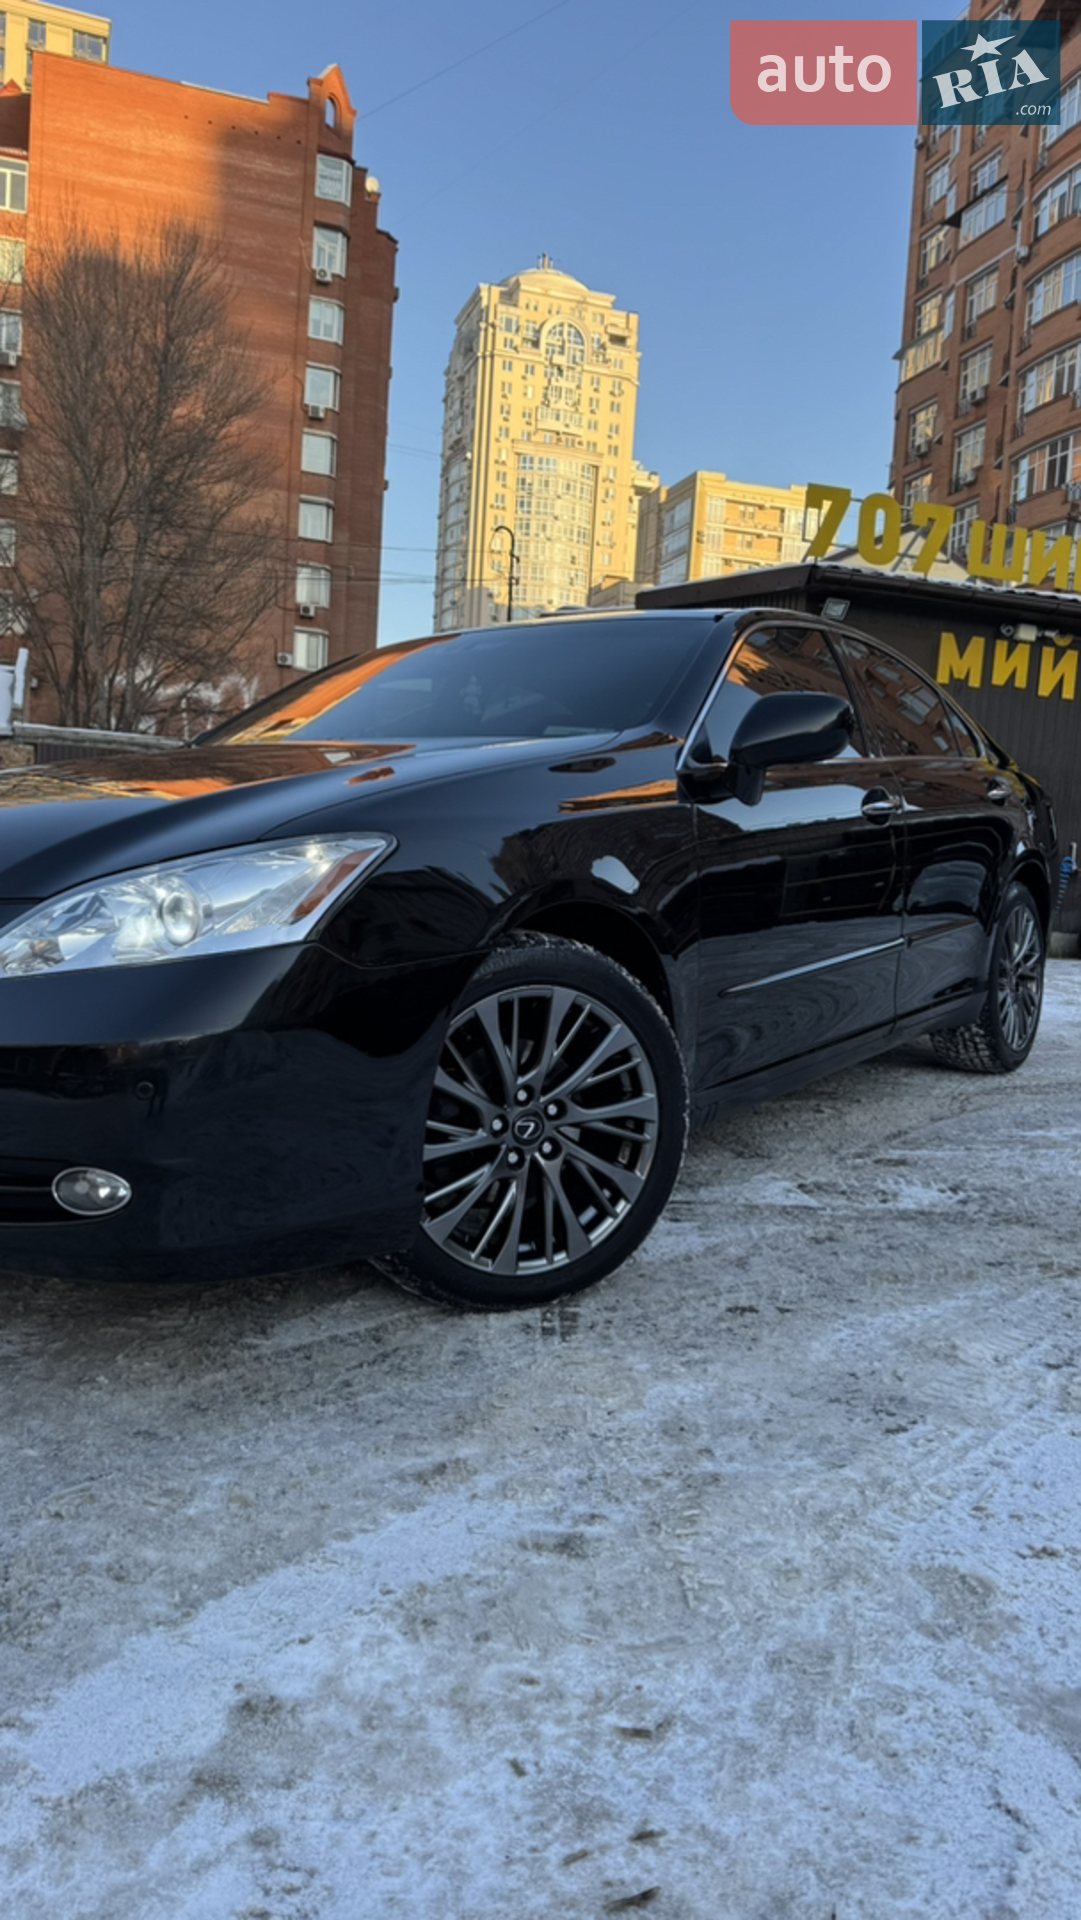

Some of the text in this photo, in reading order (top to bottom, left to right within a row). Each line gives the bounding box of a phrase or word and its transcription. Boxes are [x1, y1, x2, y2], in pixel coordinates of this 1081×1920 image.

[805, 483, 1081, 593] 707 ШИ
[936, 631, 1079, 700] МИЙ
